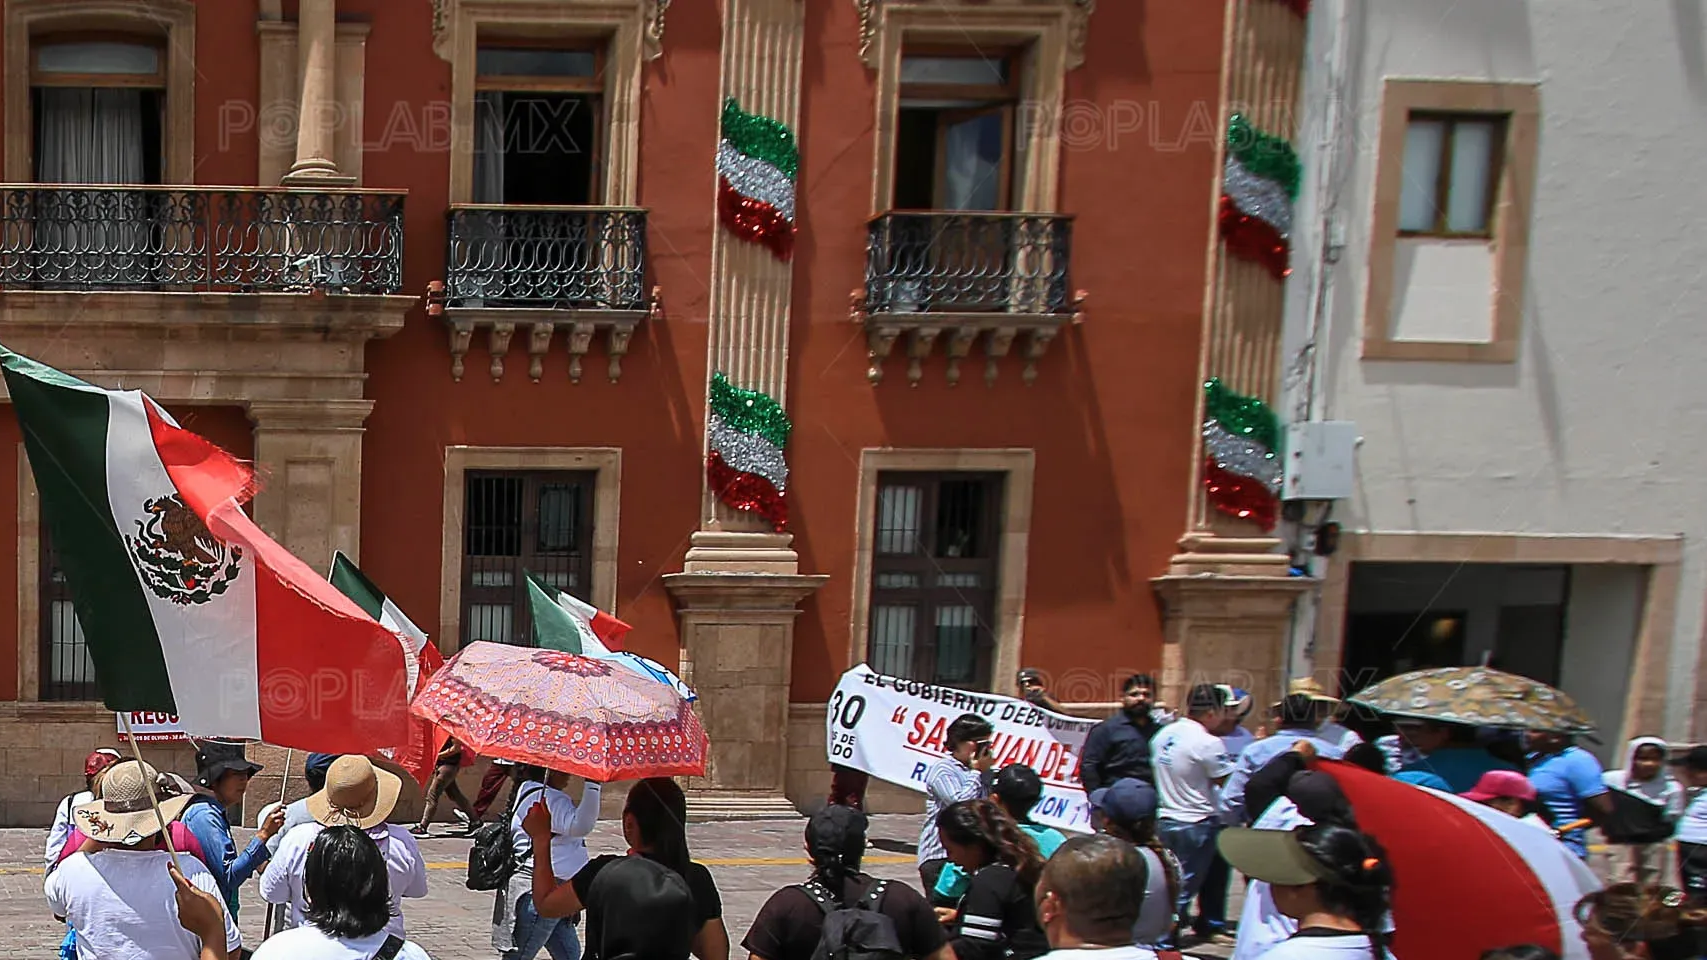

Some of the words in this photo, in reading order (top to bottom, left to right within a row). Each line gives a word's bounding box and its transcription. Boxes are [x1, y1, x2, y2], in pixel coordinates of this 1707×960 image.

[864, 674, 886, 688] EL
[894, 678, 995, 716] GOBIERNO
[1001, 704, 1044, 727] DEBE
[840, 733, 856, 746] DE
[1041, 742, 1071, 781] DE
